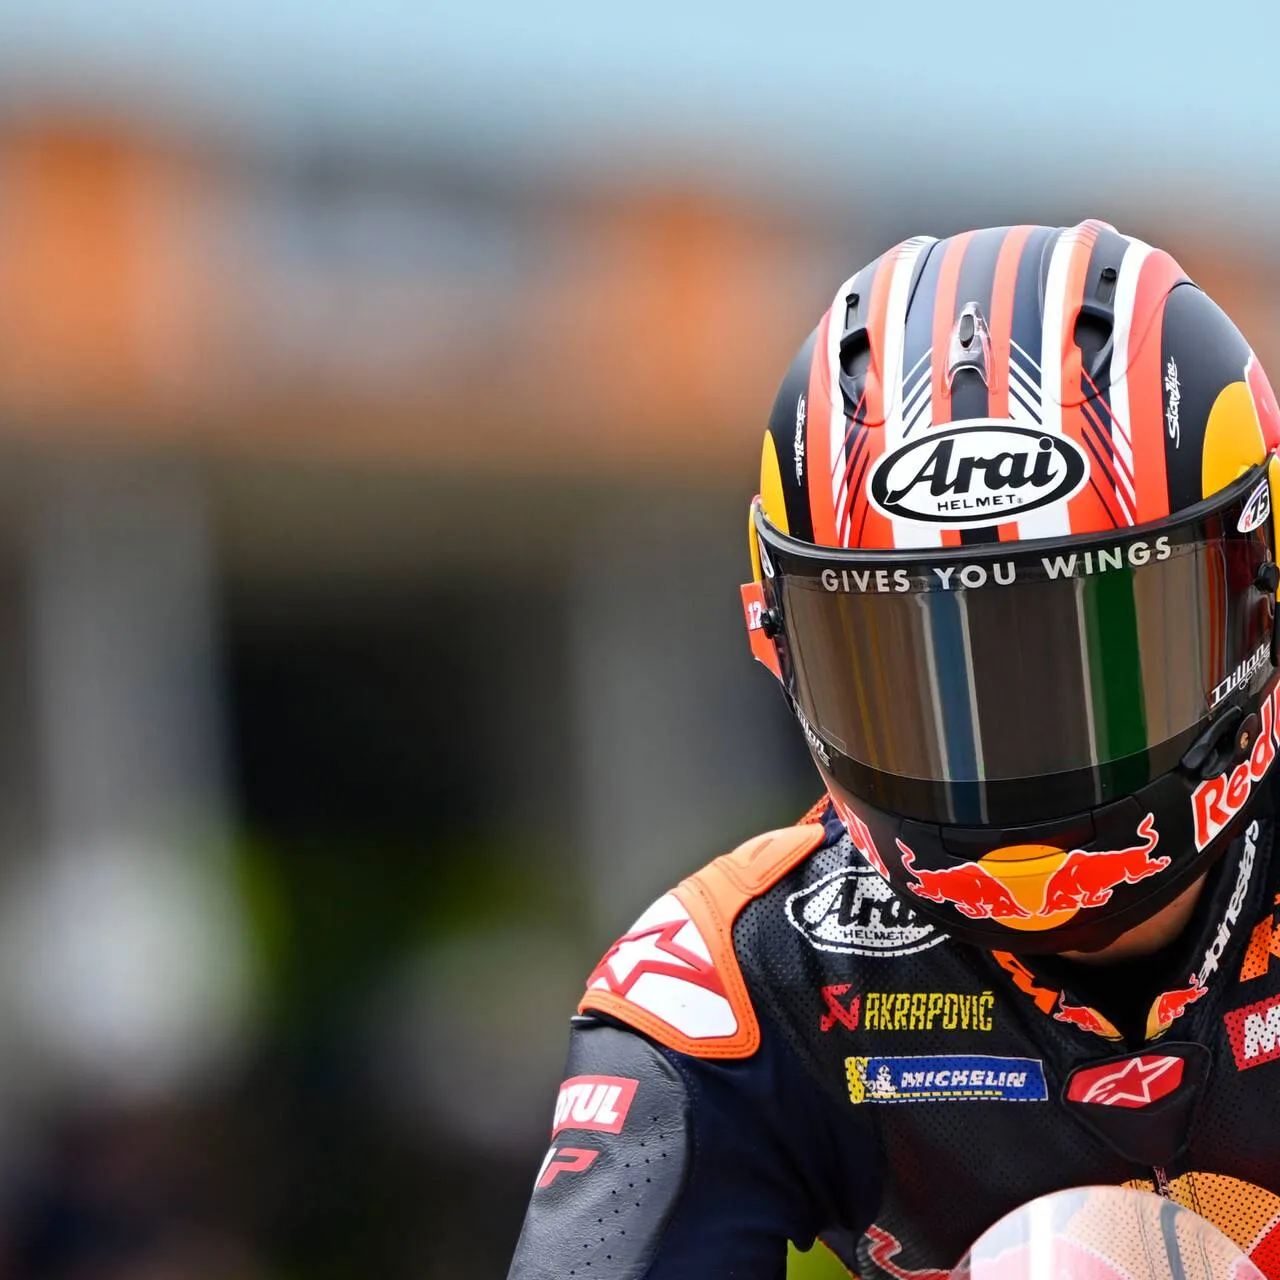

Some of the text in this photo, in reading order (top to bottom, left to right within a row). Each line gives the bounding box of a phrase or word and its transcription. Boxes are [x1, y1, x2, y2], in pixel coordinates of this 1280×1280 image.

[883, 436, 1059, 505] Arai
[937, 494, 1016, 512] HELMET
[821, 536, 1171, 593] GIVES YOU WINGS
[1190, 694, 1276, 853] Red
[803, 876, 926, 931] Ara
[1198, 819, 1260, 988] alpinestars
[842, 929, 906, 943] HELMET
[900, 1069, 1028, 1089] MICHELIN
